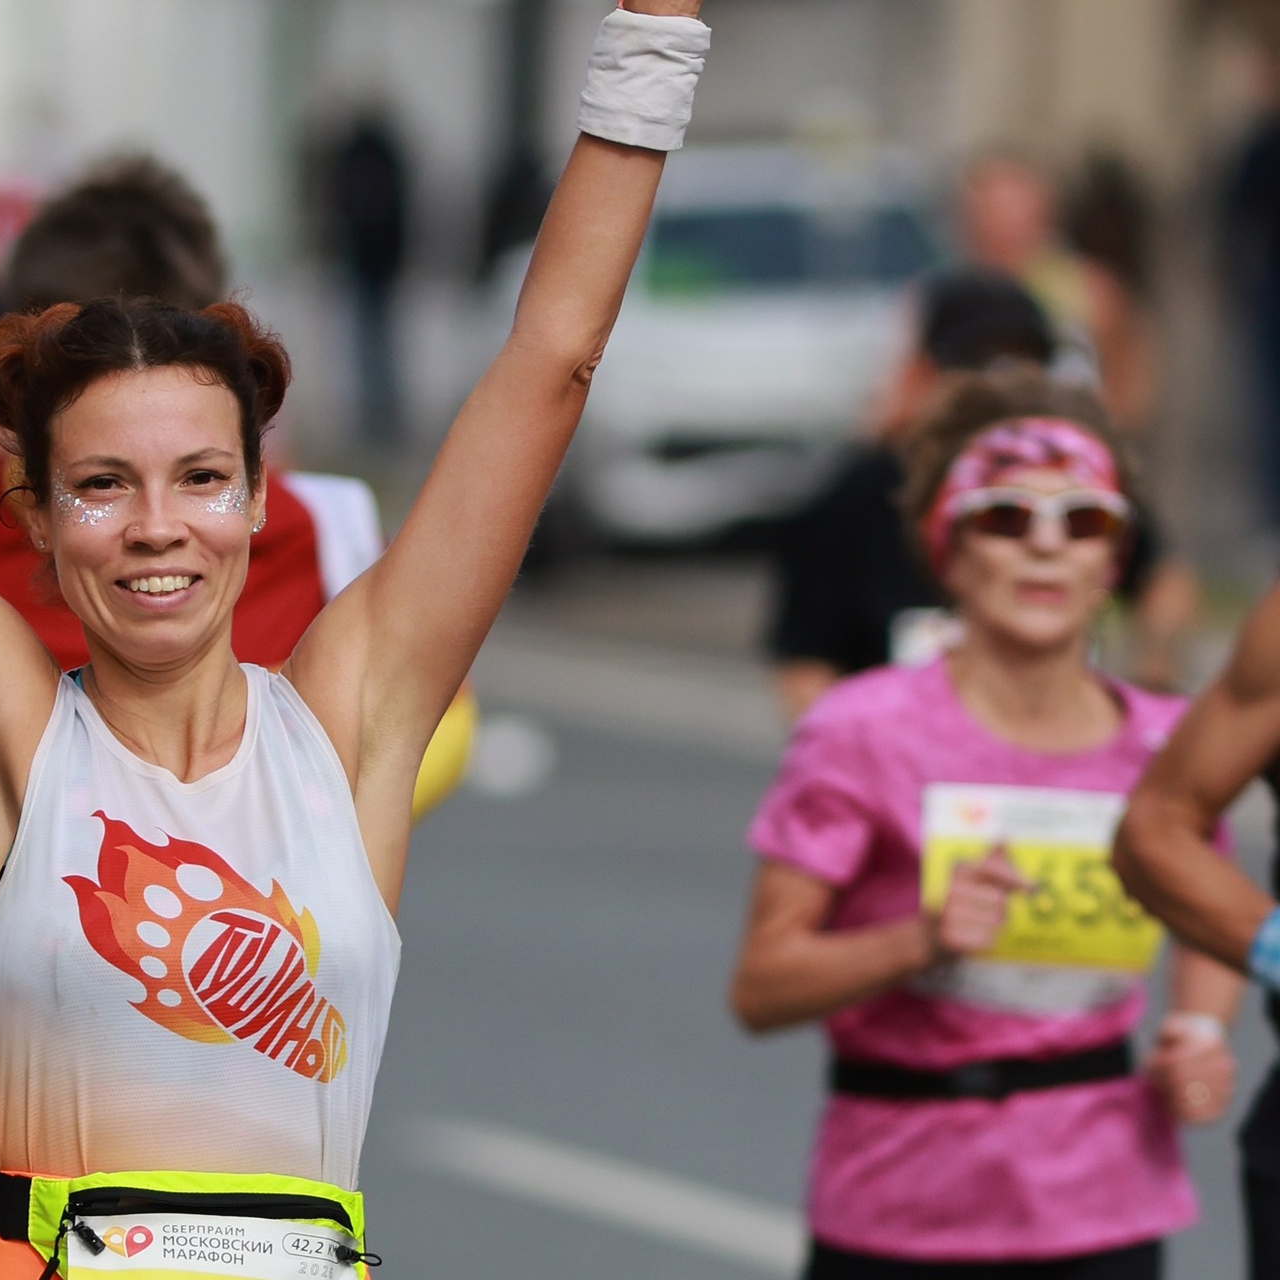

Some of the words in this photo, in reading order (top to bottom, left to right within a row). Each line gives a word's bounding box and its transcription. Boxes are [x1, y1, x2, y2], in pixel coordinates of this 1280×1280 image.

[162, 1224, 245, 1237] СБЕРПРАЙМ
[163, 1235, 273, 1254] МОСКОВСКИЙ
[291, 1238, 324, 1254] 42,2
[163, 1248, 245, 1265] МАРАФОН
